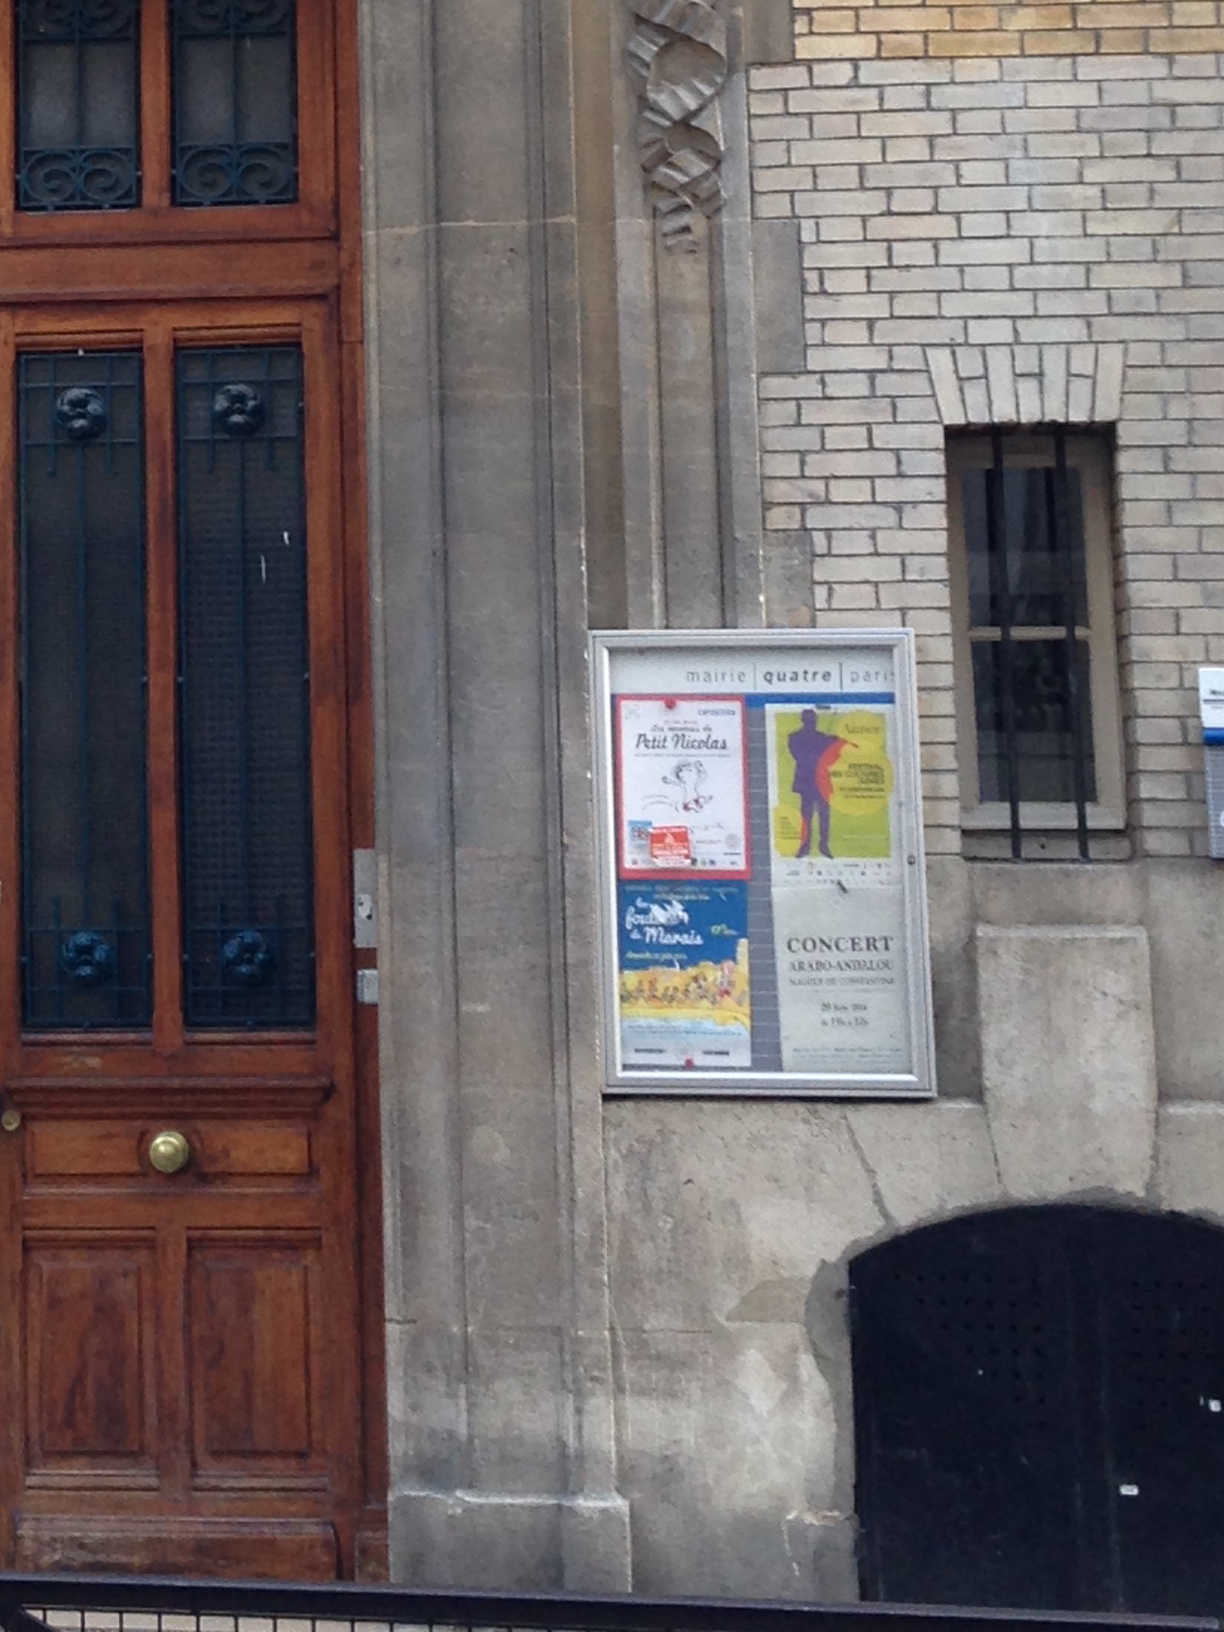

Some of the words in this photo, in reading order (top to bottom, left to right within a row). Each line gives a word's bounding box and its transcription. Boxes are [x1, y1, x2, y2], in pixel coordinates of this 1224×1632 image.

[686, 668, 746, 683] mairie
[763, 668, 832, 686] quatre
[636, 733, 668, 750] Petit
[671, 733, 728, 750] Nicolas
[644, 925, 704, 946] Marais
[786, 935, 894, 953] CONCERT
